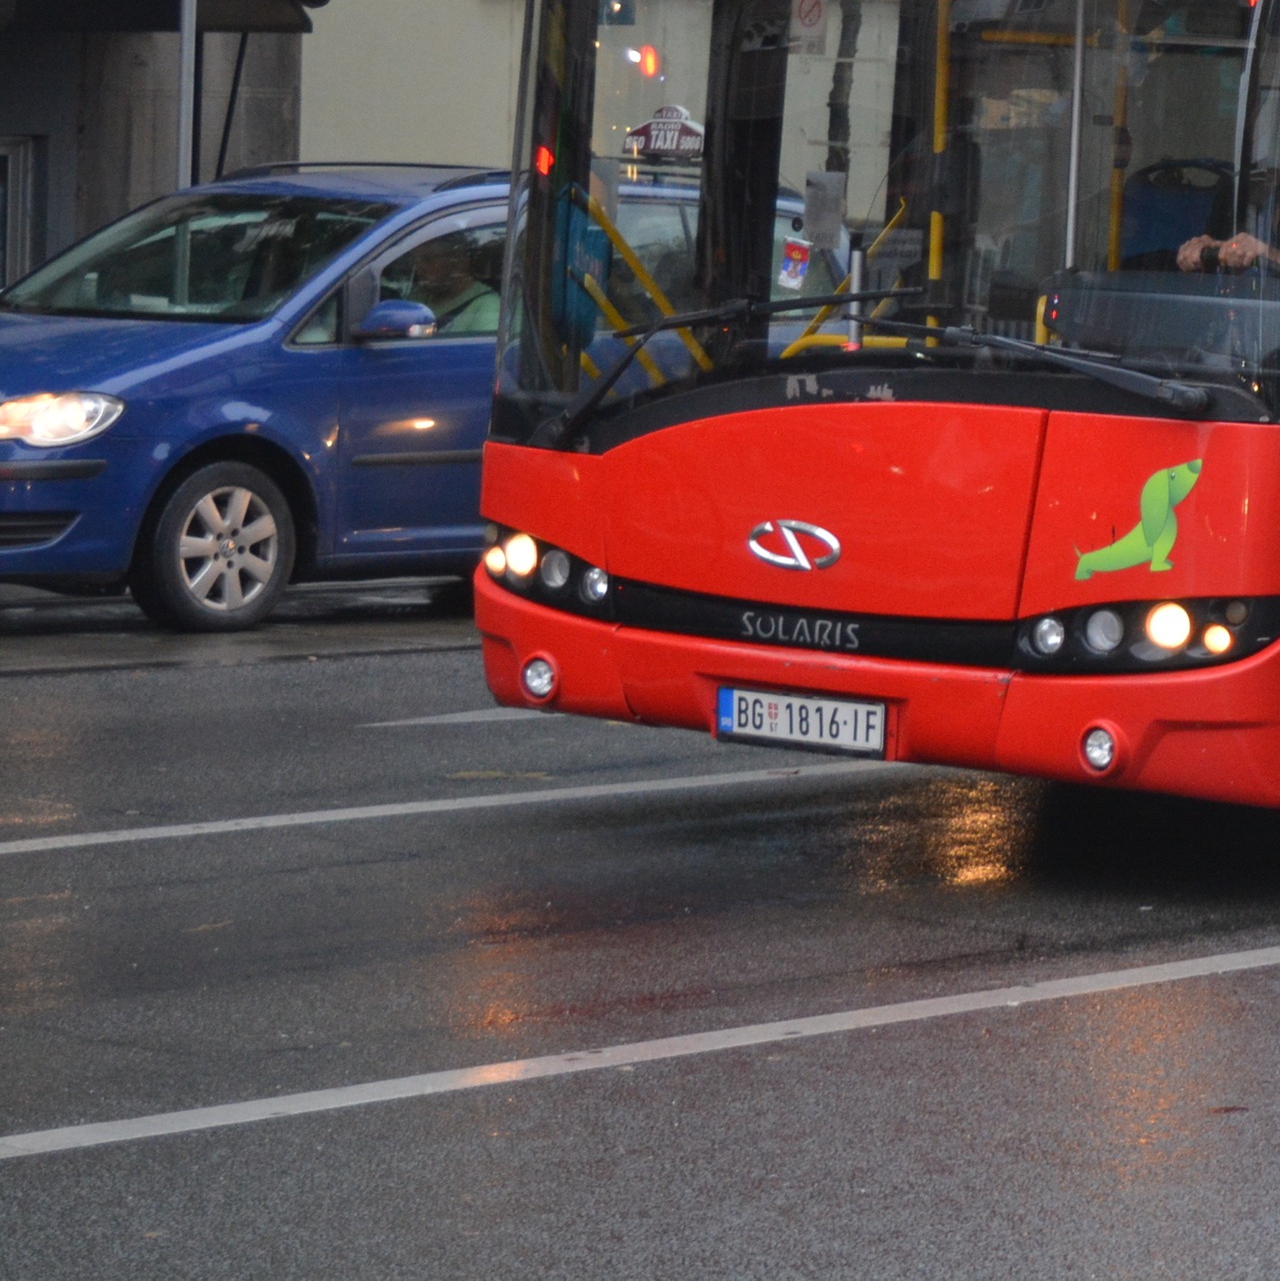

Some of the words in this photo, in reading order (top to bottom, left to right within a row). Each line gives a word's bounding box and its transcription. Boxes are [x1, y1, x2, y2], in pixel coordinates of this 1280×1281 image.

[650, 130, 680, 150] TAXI
[741, 612, 859, 649] SOLARIS
[738, 696, 764, 730] BG
